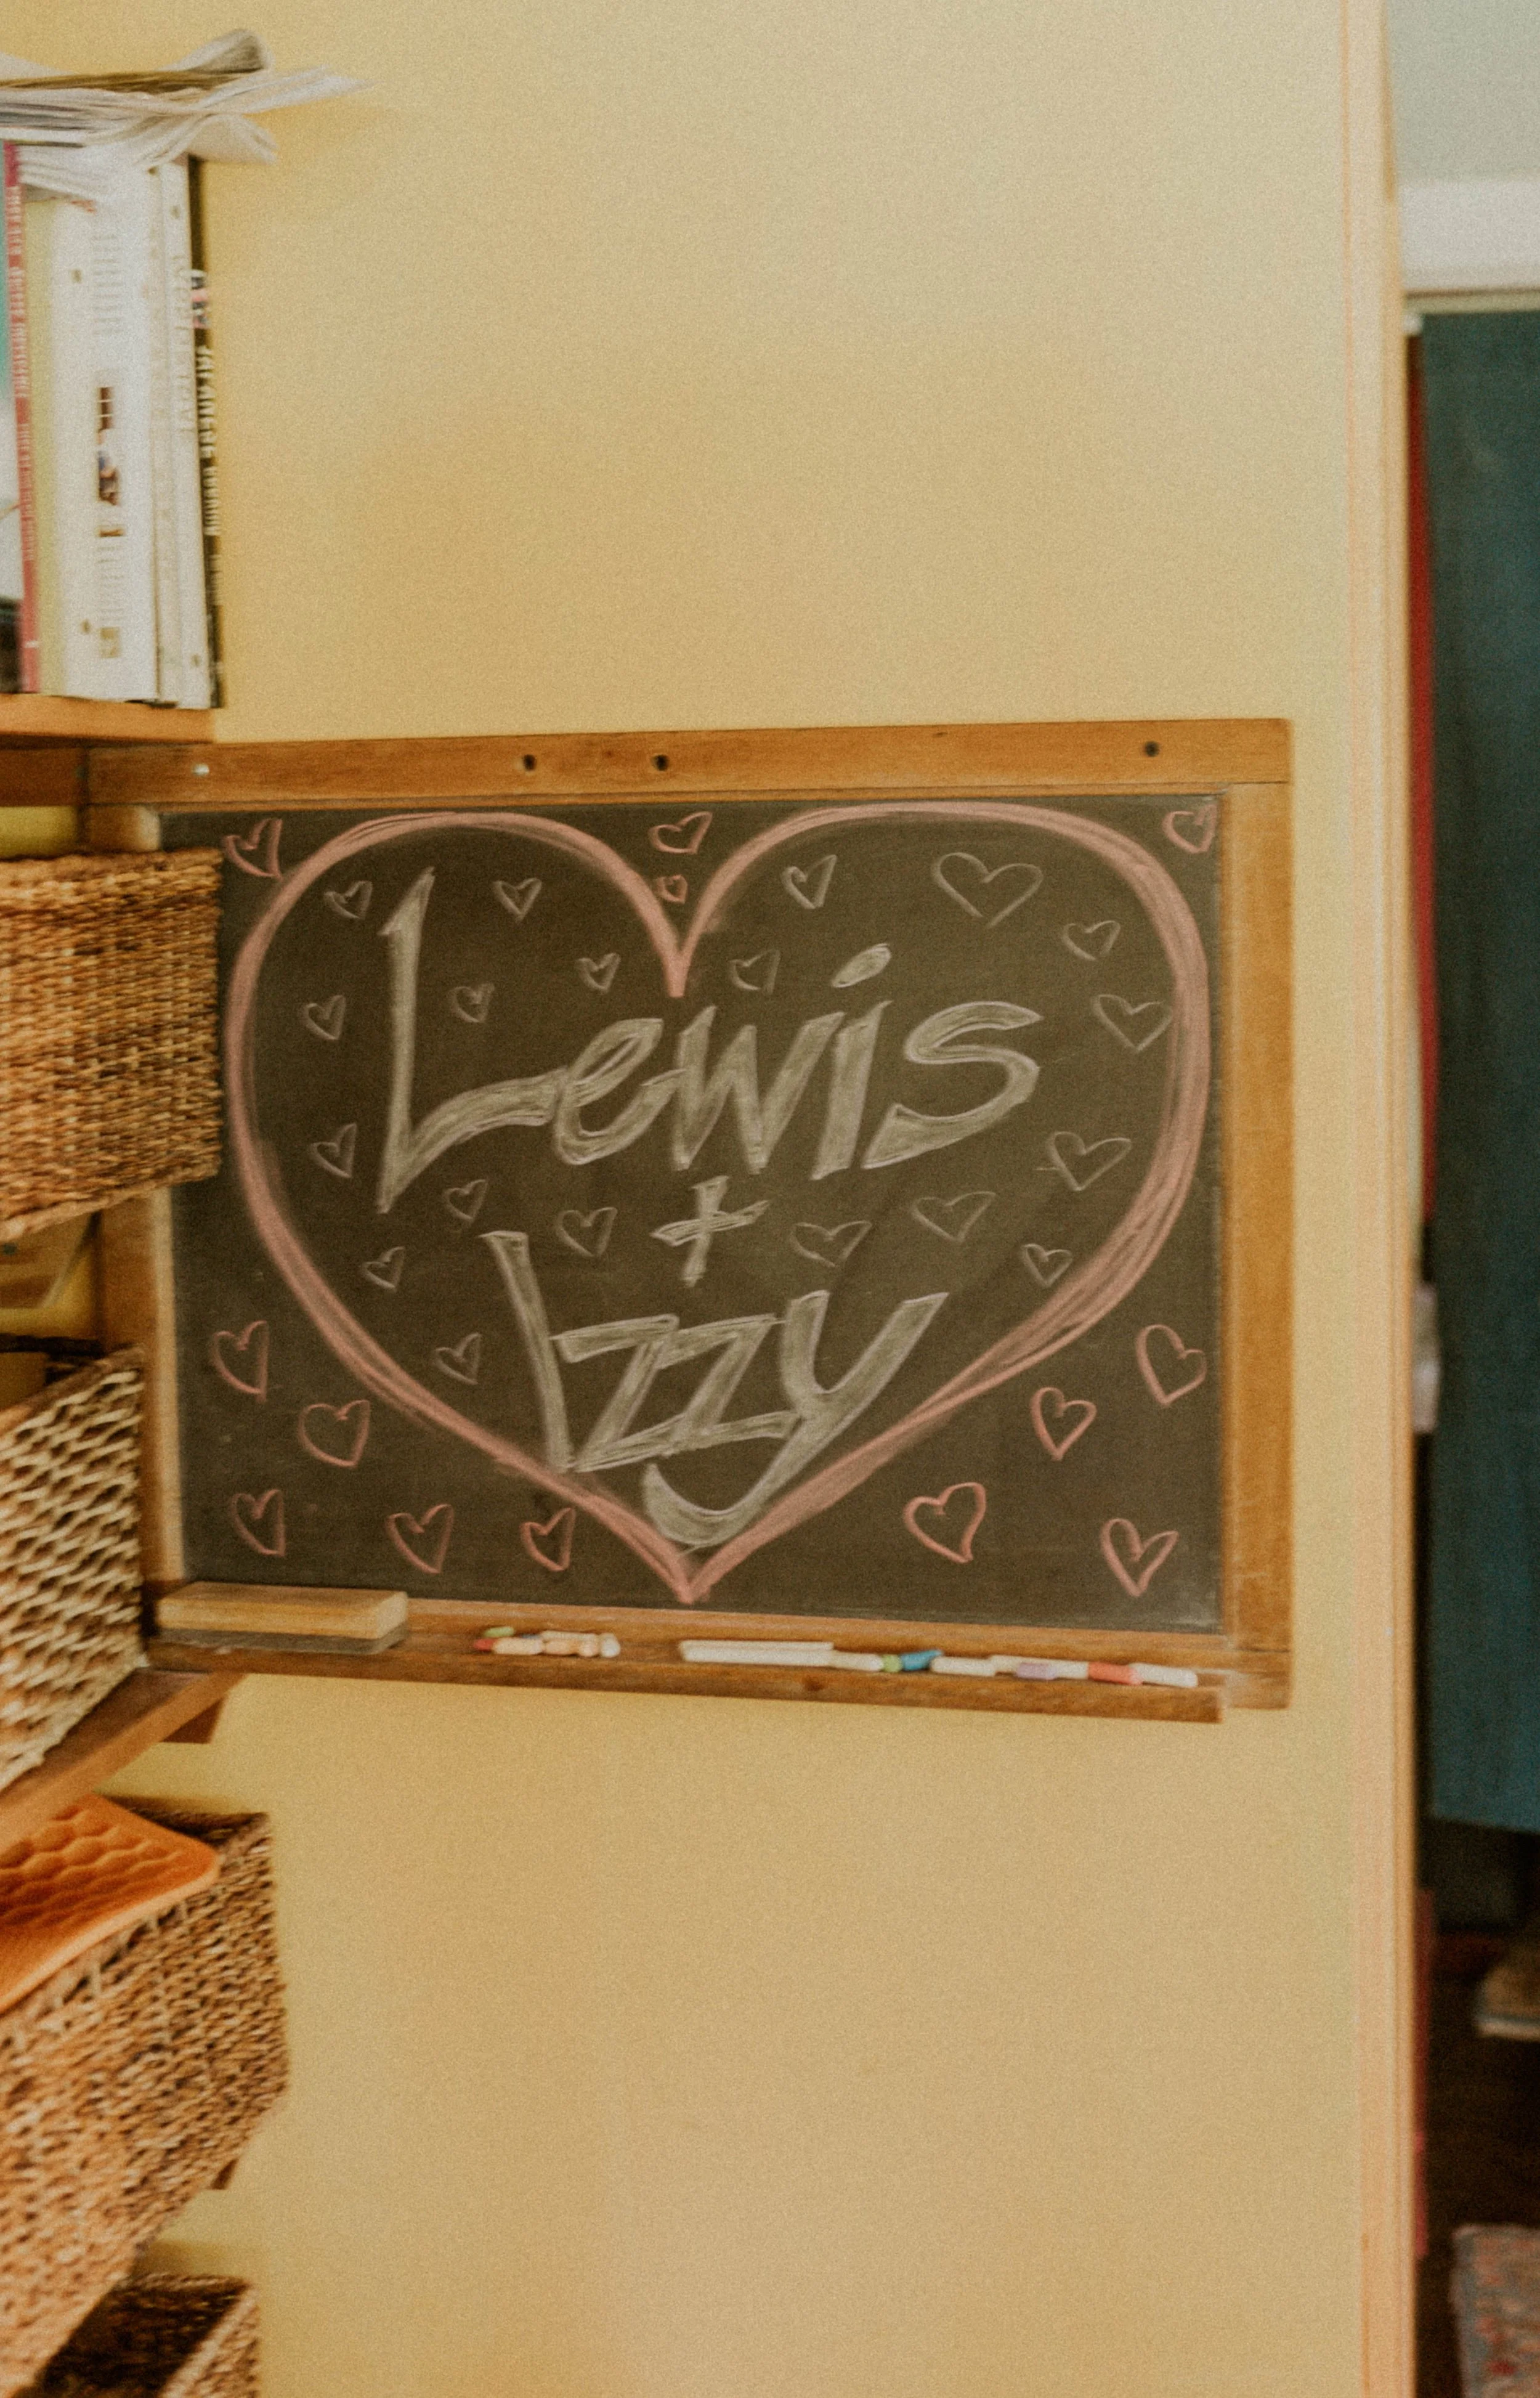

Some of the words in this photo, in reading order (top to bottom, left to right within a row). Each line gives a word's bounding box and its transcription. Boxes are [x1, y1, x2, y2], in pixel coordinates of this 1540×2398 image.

[376, 866, 1044, 1214] Lewis
[480, 1231, 949, 1549] Izzy
[651, 1176, 771, 1287] +
